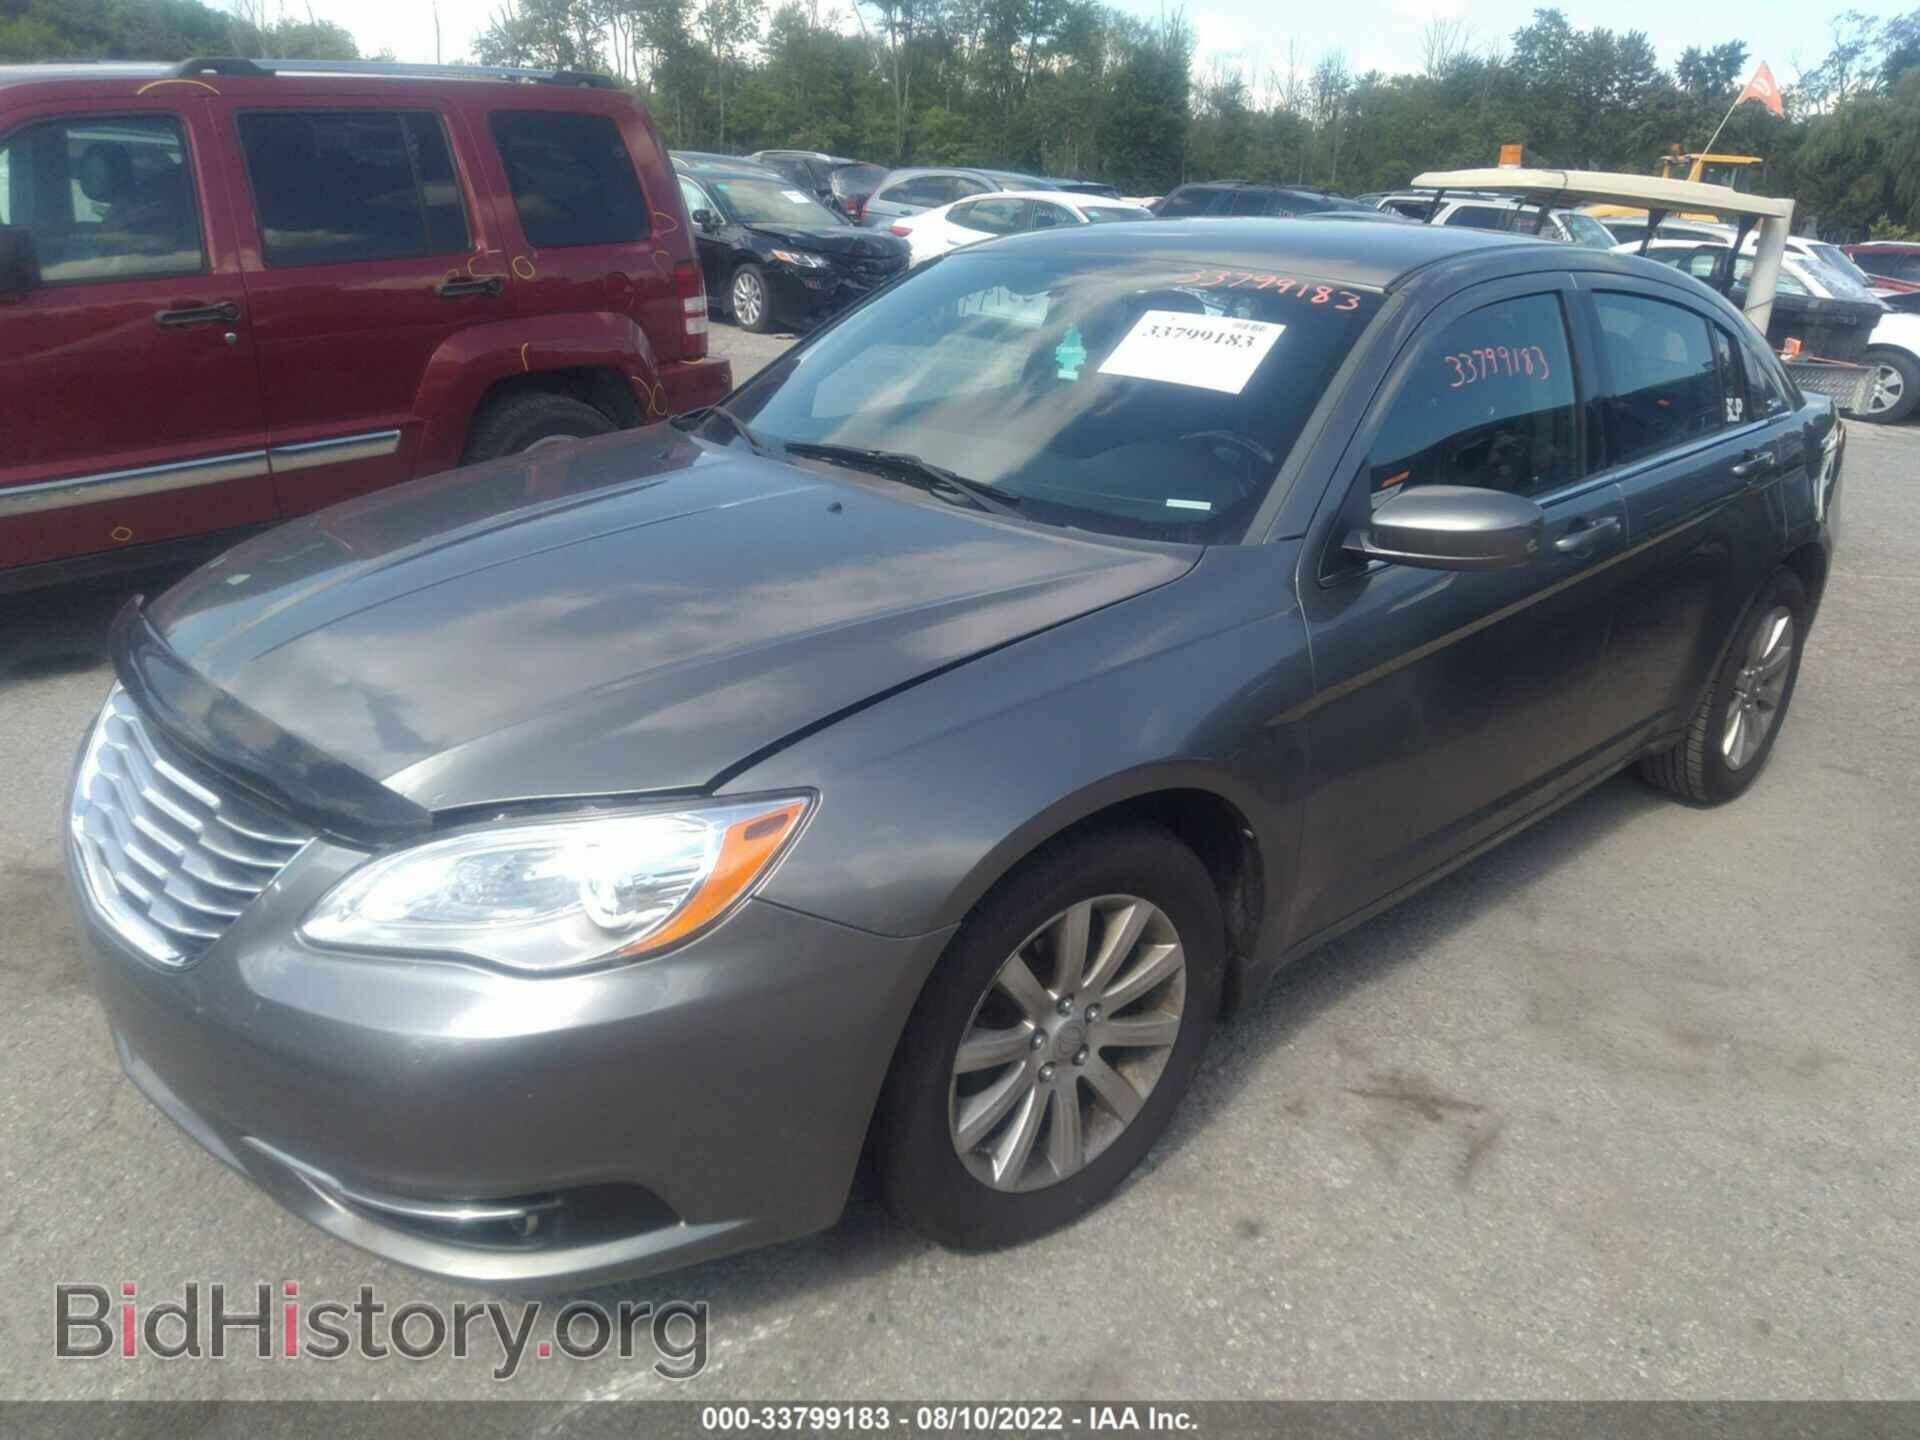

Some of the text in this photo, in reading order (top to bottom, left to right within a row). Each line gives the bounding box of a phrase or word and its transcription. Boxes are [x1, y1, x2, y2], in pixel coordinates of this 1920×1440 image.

[1174, 268, 1362, 311] 33799183
[1141, 324, 1256, 349] 33799183
[1444, 346, 1549, 388] 33799183
